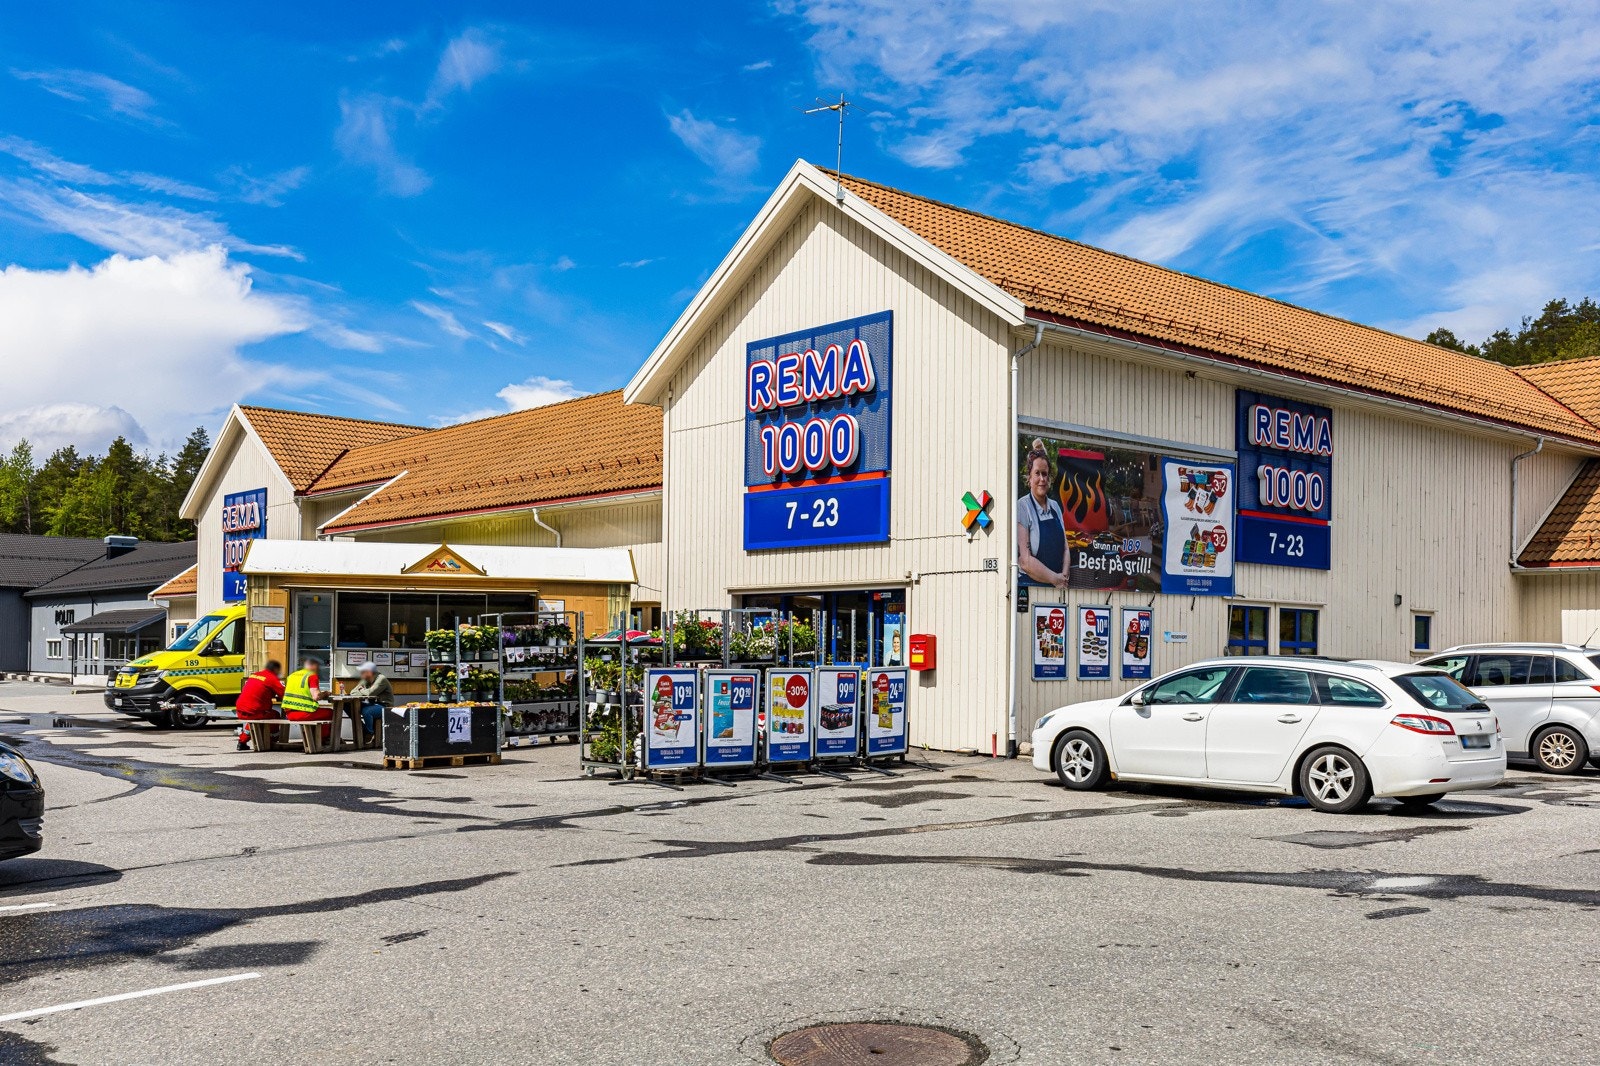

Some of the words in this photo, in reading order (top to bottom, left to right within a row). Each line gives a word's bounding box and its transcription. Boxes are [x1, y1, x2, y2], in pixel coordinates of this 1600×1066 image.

[748, 339, 872, 412] REMA
[1251, 403, 1332, 456] REMA
[760, 413, 857, 475] 1000
[1260, 464, 1324, 511] 1000
[222, 502, 259, 532] REMA
[786, 498, 838, 529] 7-23
[1093, 540, 1110, 551] Grunn
[1122, 538, 1141, 552] 189
[1269, 533, 1304, 557] 7-23
[985, 560, 998, 568] 183
[1079, 552, 1106, 571] Best
[1109, 555, 1123, 574] på
[1125, 557, 1152, 576] grill!
[235, 580, 247, 594] 7-2
[55, 609, 74, 625] POLITI
[787, 687, 807, 696] -30%
